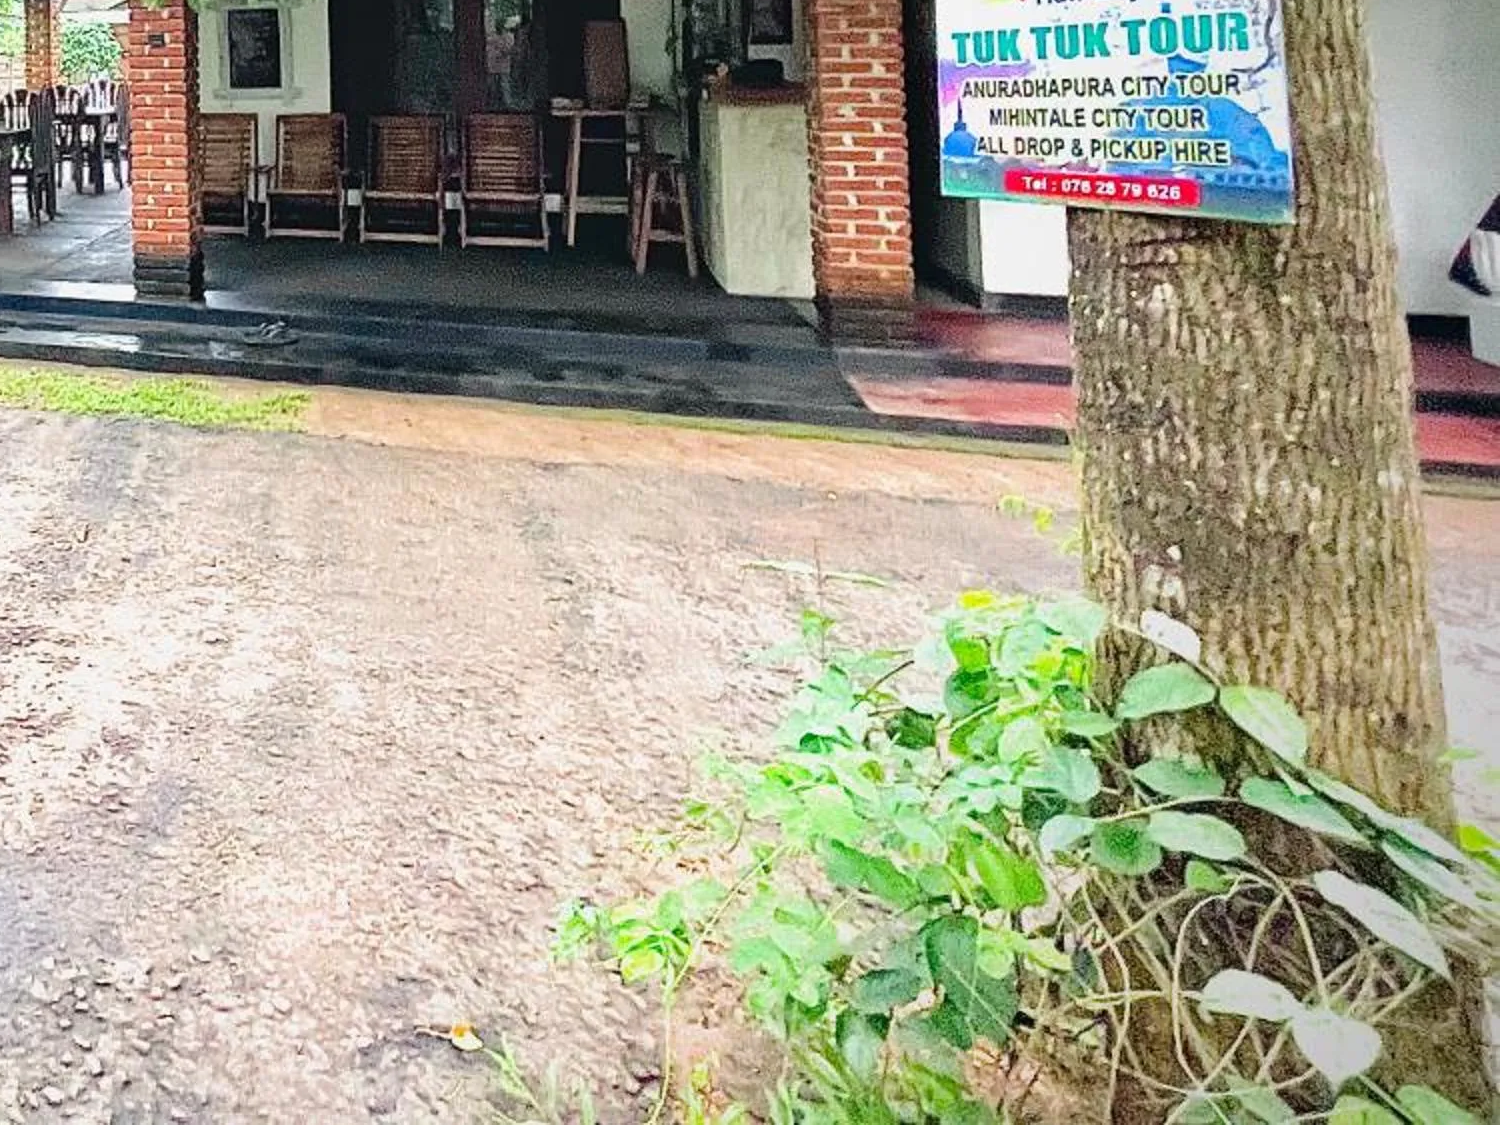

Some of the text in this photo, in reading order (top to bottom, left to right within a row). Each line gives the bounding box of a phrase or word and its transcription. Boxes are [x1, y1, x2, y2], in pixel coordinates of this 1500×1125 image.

[952, 11, 1249, 64] TUK TUK TOUR
[962, 74, 1241, 99] ANURADHAPURA CITY TOUR
[989, 108, 1205, 128] MIHINTALE CITY TOUR
[977, 136, 1230, 164] ALL DROP & PICKUP HIRE
[1022, 176, 1047, 191] Tel
[1121, 182, 1143, 198] 79
